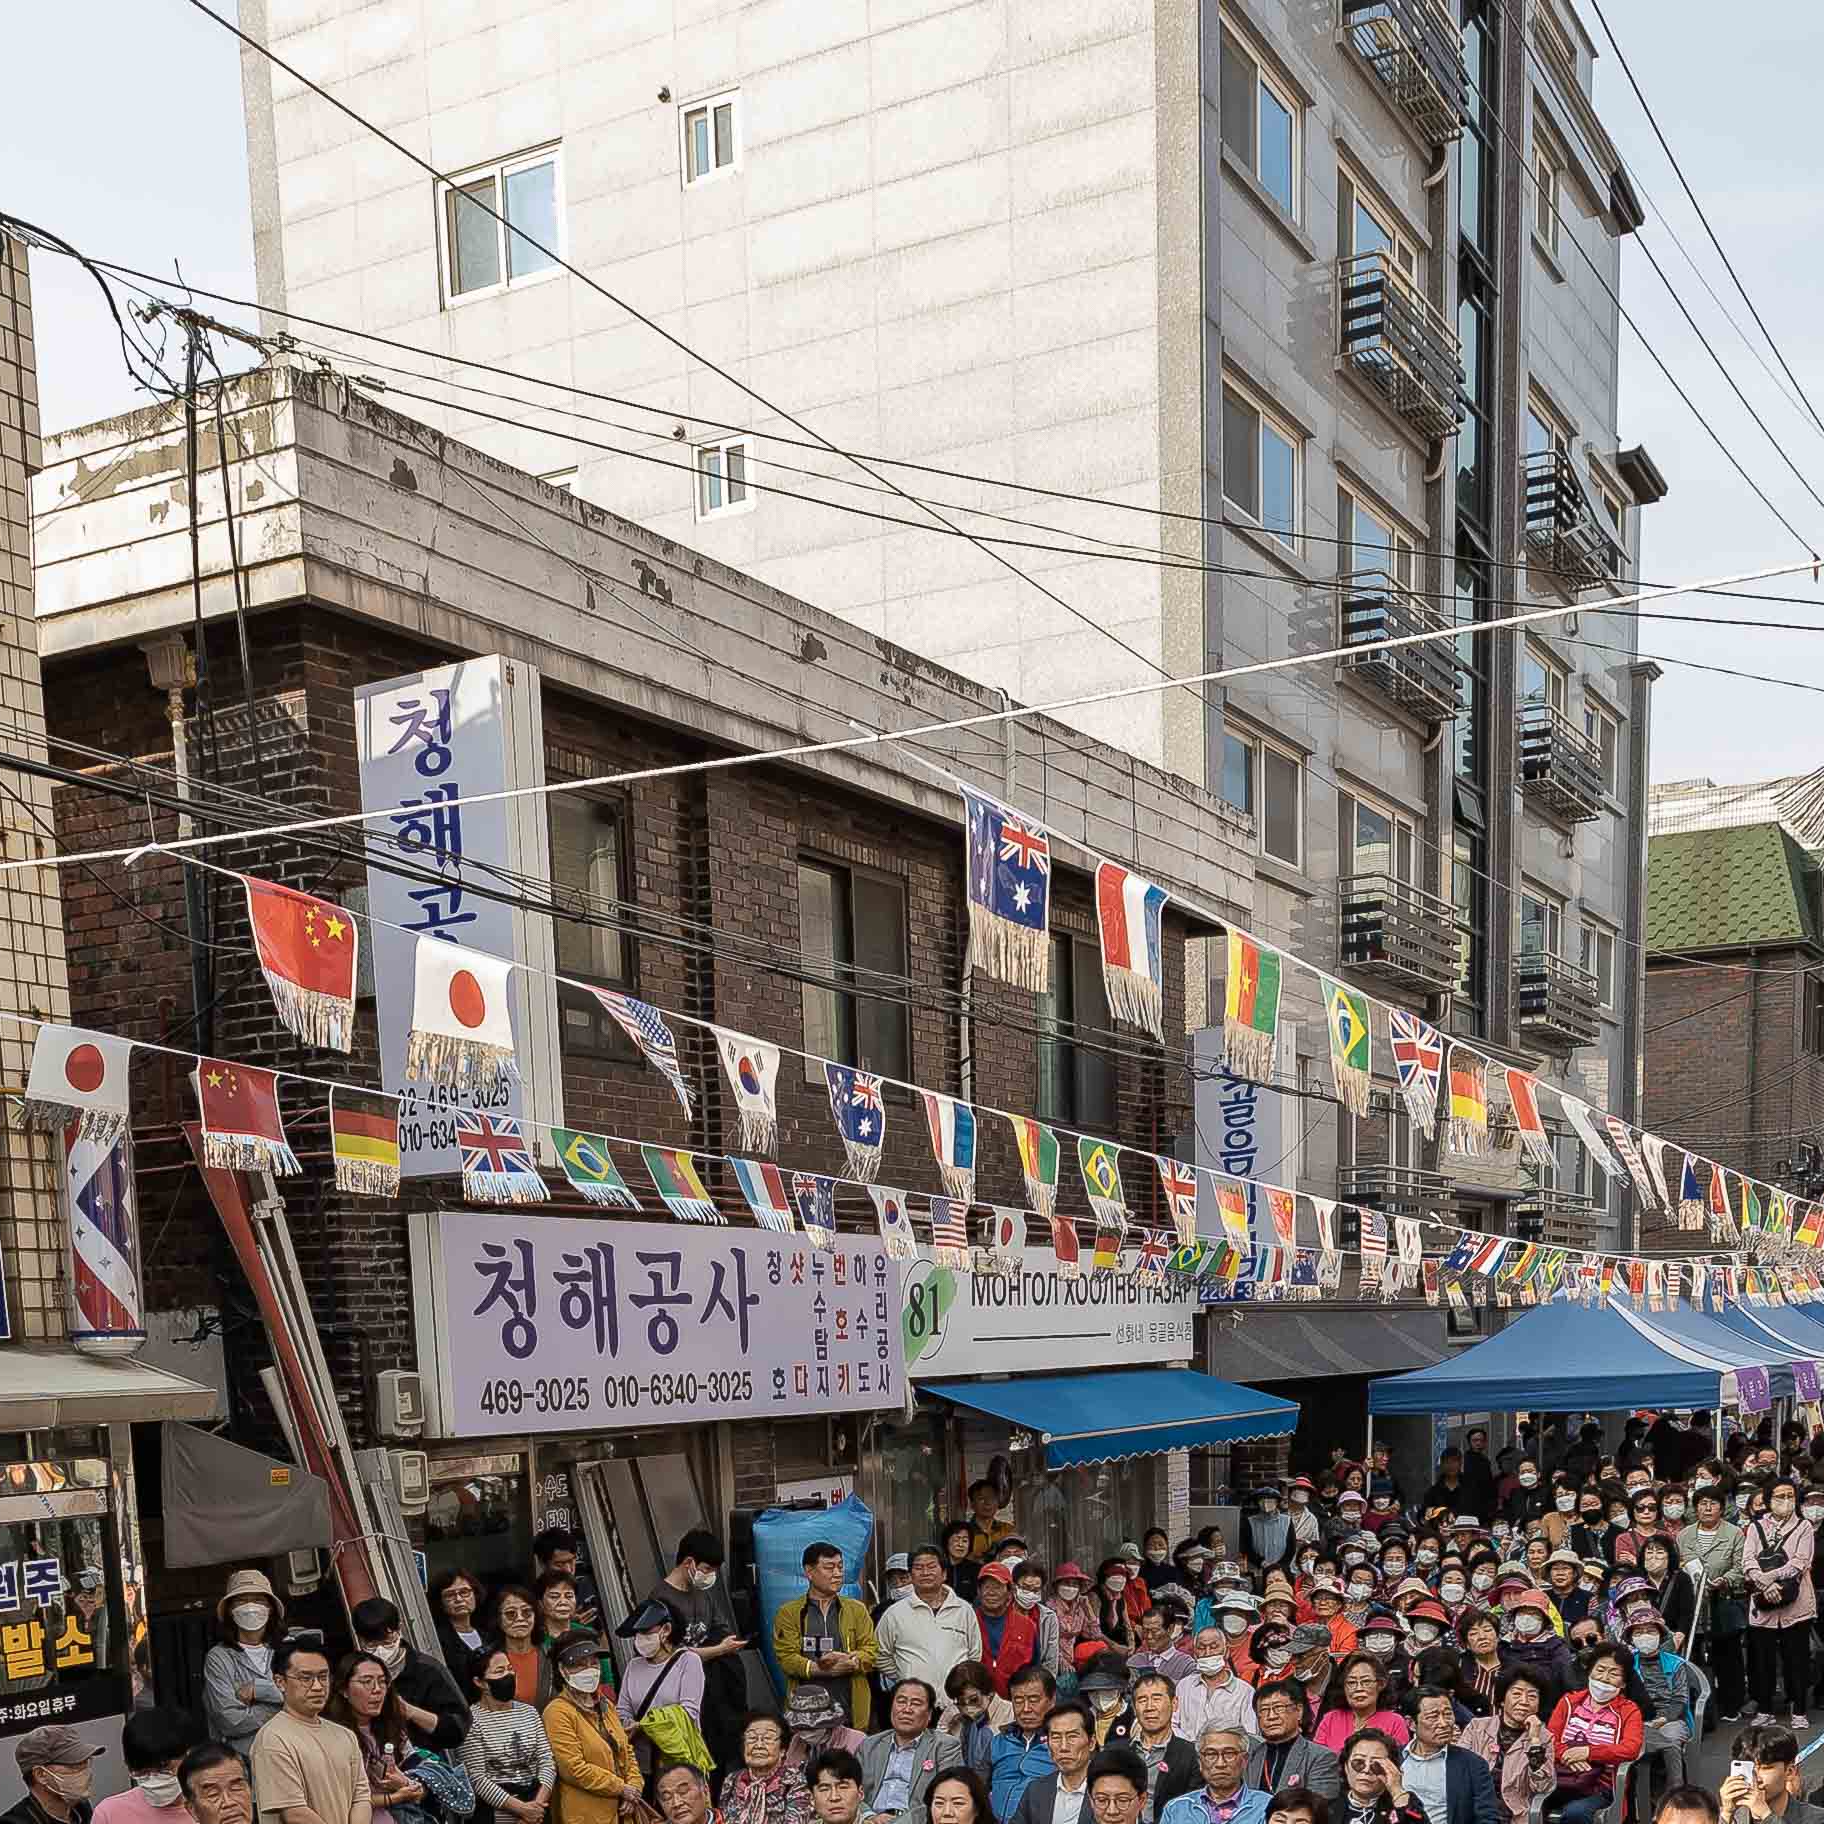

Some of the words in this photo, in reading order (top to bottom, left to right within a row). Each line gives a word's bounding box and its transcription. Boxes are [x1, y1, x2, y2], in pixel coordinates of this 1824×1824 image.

[388, 689, 476, 944] 청해공
[399, 1121, 457, 1151] 010-634
[473, 1239, 760, 1358] 청해공사
[812, 1253, 830, 1397] 누수탐지
[874, 1254, 891, 1394] 유리공사
[909, 1282, 941, 1337] 81
[972, 1272, 1058, 1306] МОНГОЛ
[480, 1377, 590, 1415] 469-3025
[604, 1371, 752, 1408] 010-6340-3025
